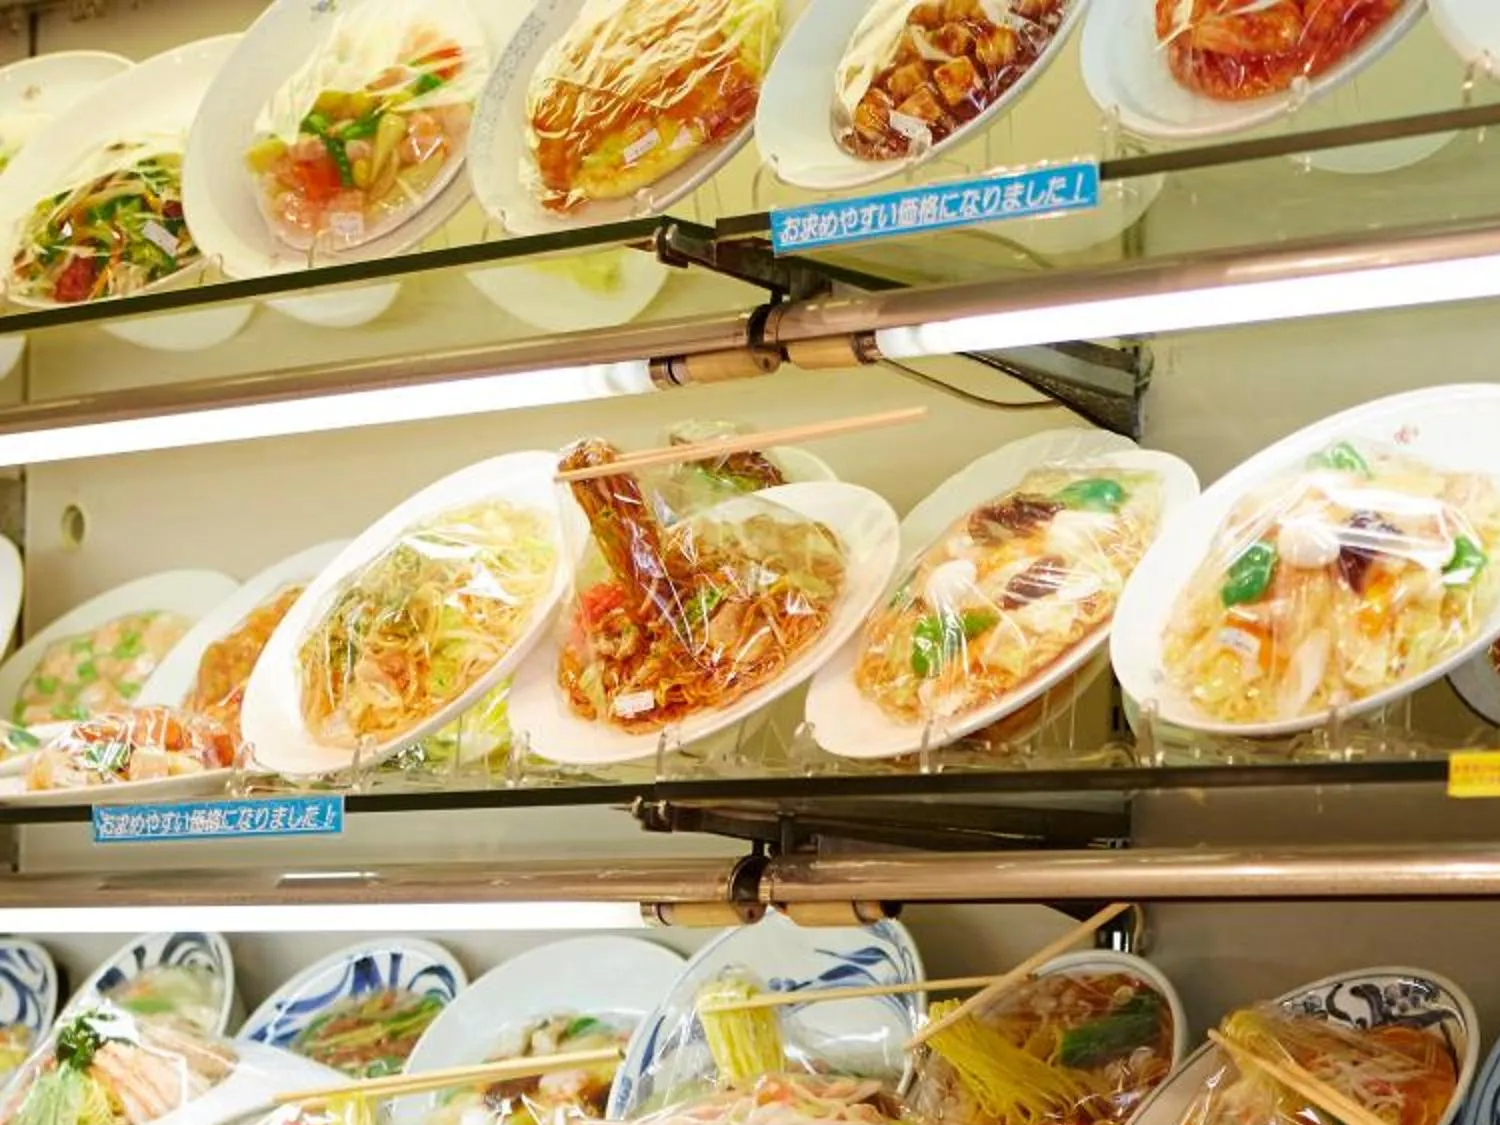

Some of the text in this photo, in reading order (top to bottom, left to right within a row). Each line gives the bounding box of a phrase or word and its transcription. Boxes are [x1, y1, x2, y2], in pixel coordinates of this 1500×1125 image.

[780, 172, 1087, 244] お求めやすい価格になりました！
